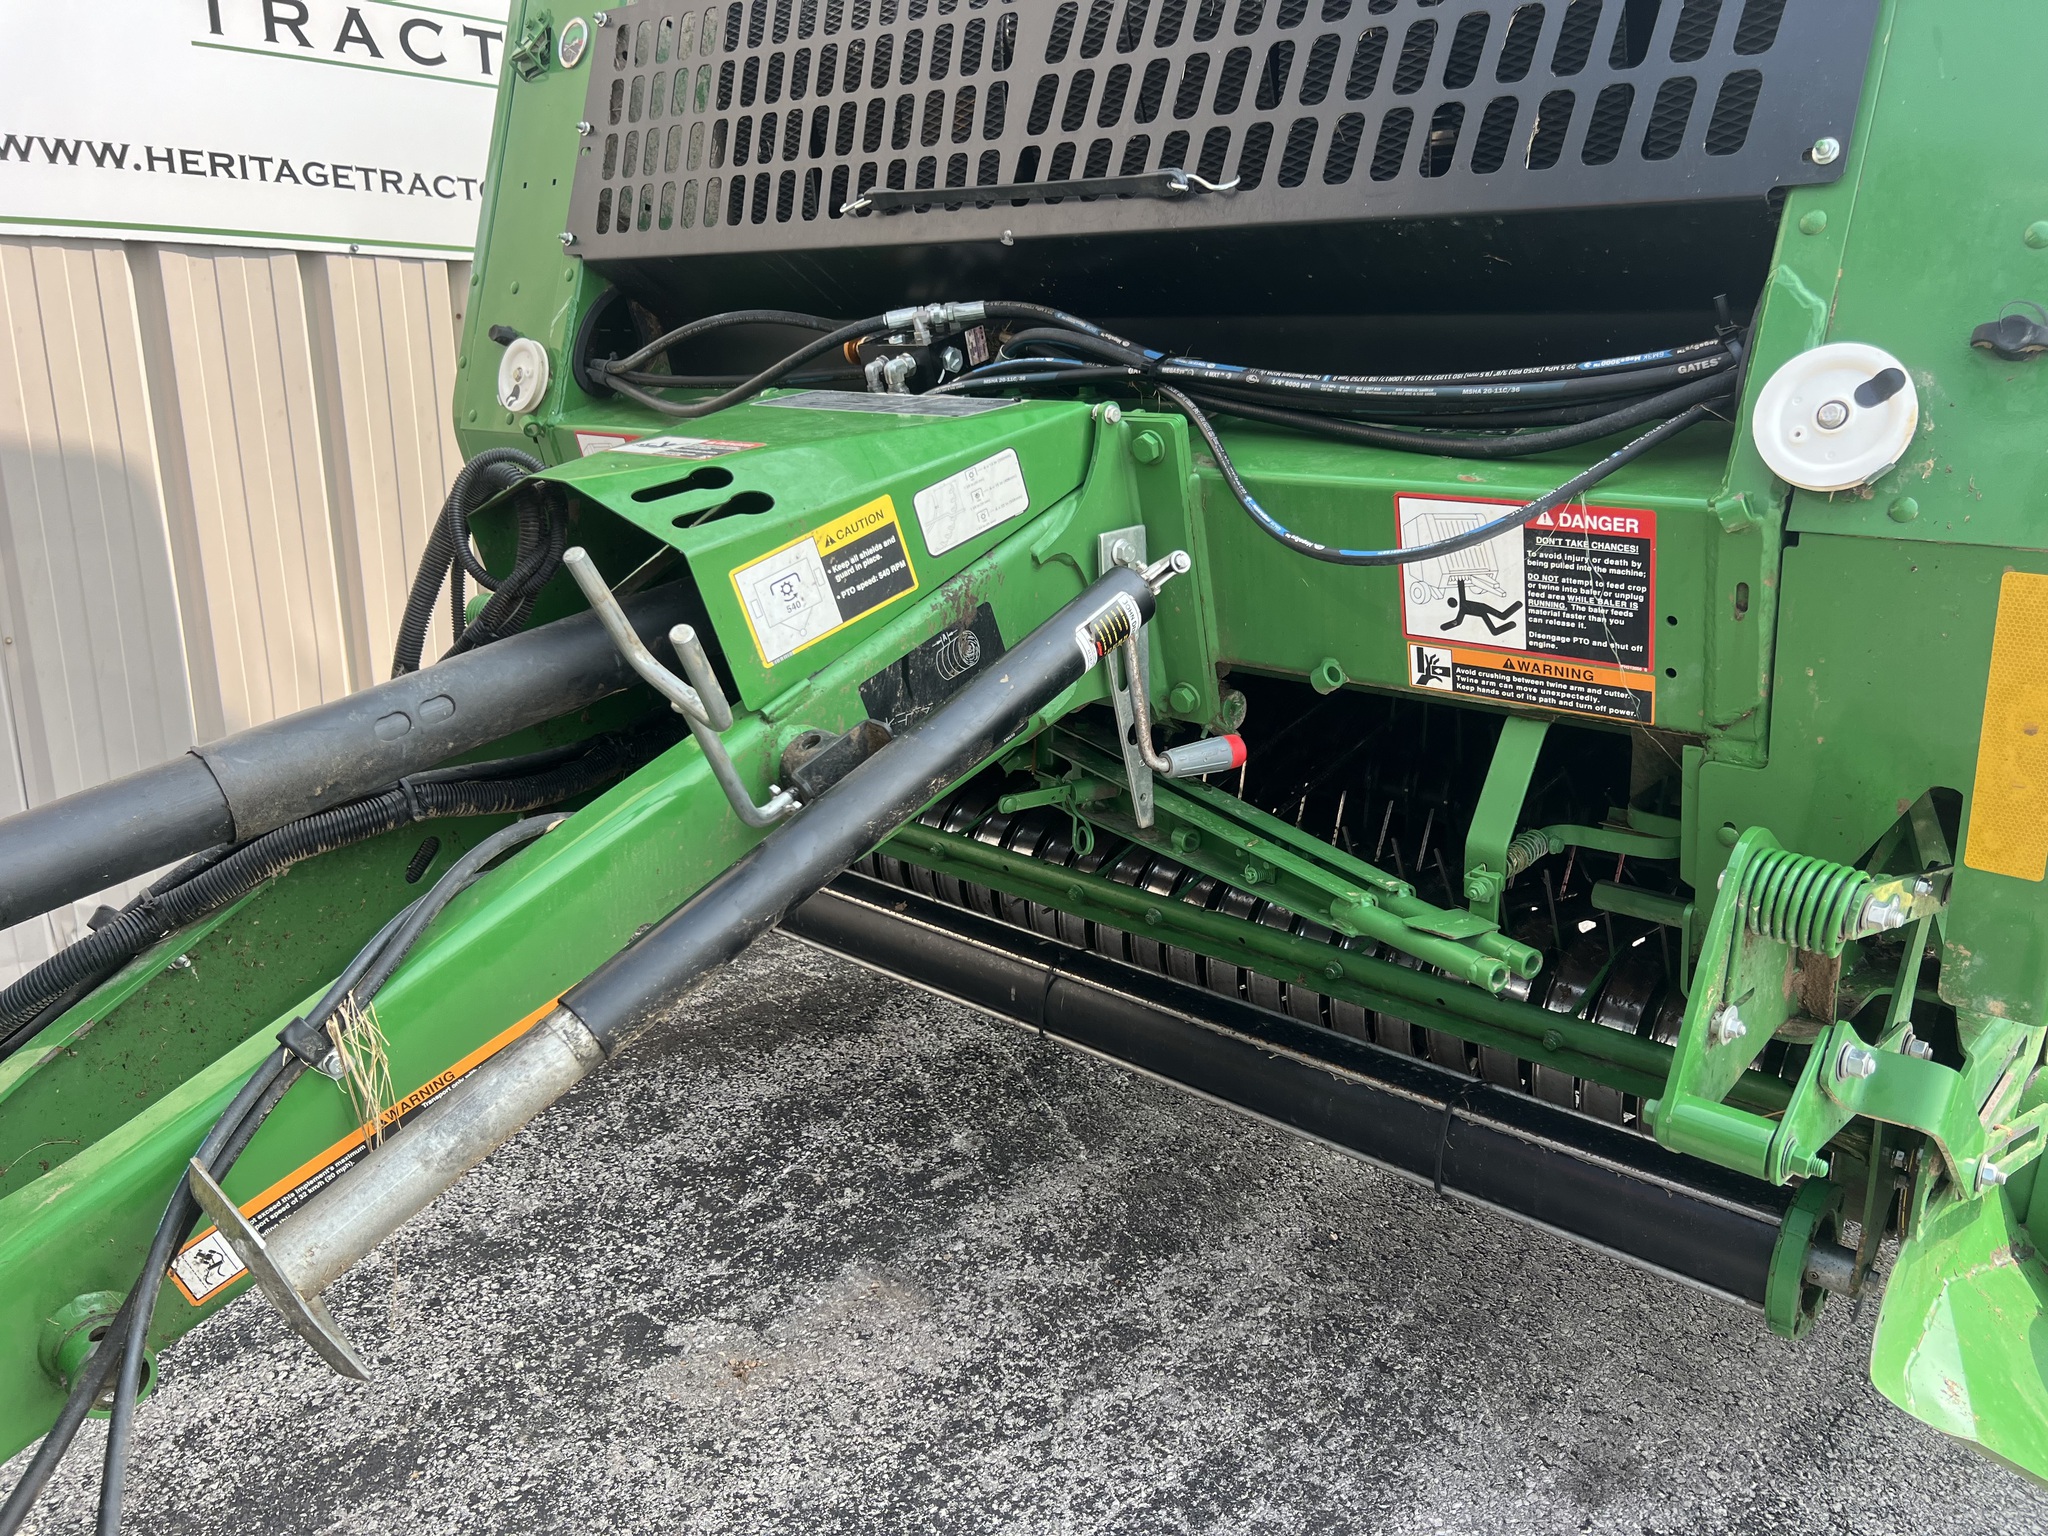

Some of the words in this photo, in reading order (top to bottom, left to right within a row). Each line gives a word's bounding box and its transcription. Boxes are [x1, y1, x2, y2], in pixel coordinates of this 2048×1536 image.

[0, 133, 485, 201] WWW.HERITAGETRACT
[835, 509, 885, 541] CAUTION
[1559, 513, 1639, 533] DANGER
[831, 558, 851, 574] Keep
[849, 553, 859, 564] all
[858, 541, 883, 560] shields
[882, 535, 897, 548] and
[1536, 536, 1562, 546] DON'T
[1565, 539, 1589, 548] TAKE
[1591, 541, 1639, 553] CHANCES!
[834, 565, 855, 583] guard
[854, 562, 863, 571] in
[861, 552, 883, 568] place.
[1527, 559, 1549, 568] being
[1550, 561, 1575, 571] pulled
[1576, 564, 1592, 572] into
[1594, 565, 1607, 573] the
[1609, 567, 1647, 578] machine;
[1539, 551, 1562, 560] avoid
[1564, 554, 1589, 564] injury
[1604, 558, 1629, 567] death
[1631, 561, 1642, 570] by
[840, 585, 856, 599] PTO
[856, 573, 879, 594] speed:
[877, 567, 892, 580] 540
[890, 559, 907, 573] RPM
[1561, 577, 1593, 587] attempt
[1606, 581, 1625, 590] feed
[1627, 585, 1647, 594] crop
[1528, 591, 1545, 599] feed
[1567, 595, 1595, 604] WHILE
[1597, 598, 1627, 608] BALER
[1538, 583, 1560, 591] twine
[1580, 587, 1601, 596] baler
[1614, 591, 1644, 602] unplug
[786, 601, 801, 614] 540
[1122, 599, 1135, 620] JOHN
[1528, 599, 1568, 610] RUNNING.
[1570, 604, 1586, 612] The
[1588, 606, 1609, 614] baler
[1610, 608, 1634, 617] feeds
[1528, 608, 1560, 617] material
[1562, 612, 1586, 620] faster
[1588, 614, 1607, 623] than
[1609, 618, 1625, 627] you
[1545, 618, 1576, 628] release
[1529, 631, 1570, 644] Disengage
[1572, 635, 1589, 644] PTO
[1592, 638, 1607, 648] and
[1610, 641, 1629, 651] shut
[1631, 644, 1643, 652] off
[1529, 640, 1558, 650] engine.
[1517, 661, 1595, 682] WARNING
[1455, 675, 1480, 685] Twine
[1516, 685, 1538, 693] move
[1540, 688, 1601, 703] unexpectedly.
[1456, 667, 1477, 676] Avoid
[1478, 670, 1511, 682] crushing
[1512, 675, 1544, 686] between
[1546, 681, 1568, 690] twine
[1587, 687, 1602, 695] and
[1604, 689, 1631, 699] cutter.
[1456, 683, 1475, 692] Keep
[1477, 686, 1500, 695] hands
[1502, 690, 1515, 698] out
[1516, 691, 1525, 699] of
[1526, 693, 1537, 701] its
[1539, 696, 1556, 705] path
[1559, 699, 1574, 707] and
[1576, 701, 1593, 710] turn
[1595, 704, 1606, 712] off
[1609, 707, 1637, 718] power.
[385, 1070, 456, 1122] WARNING
[421, 1086, 452, 1109] Transport
[257, 1201, 282, 1219] exceed
[281, 1191, 295, 1204] this
[295, 1165, 335, 1195] implement's
[334, 1144, 366, 1168] maximum
[269, 1203, 291, 1221] speed
[290, 1197, 299, 1206] of
[298, 1191, 308, 1200] 32
[307, 1179, 325, 1194] km/h
[324, 1172, 336, 1183] (20
[335, 1159, 356, 1176] mph).
